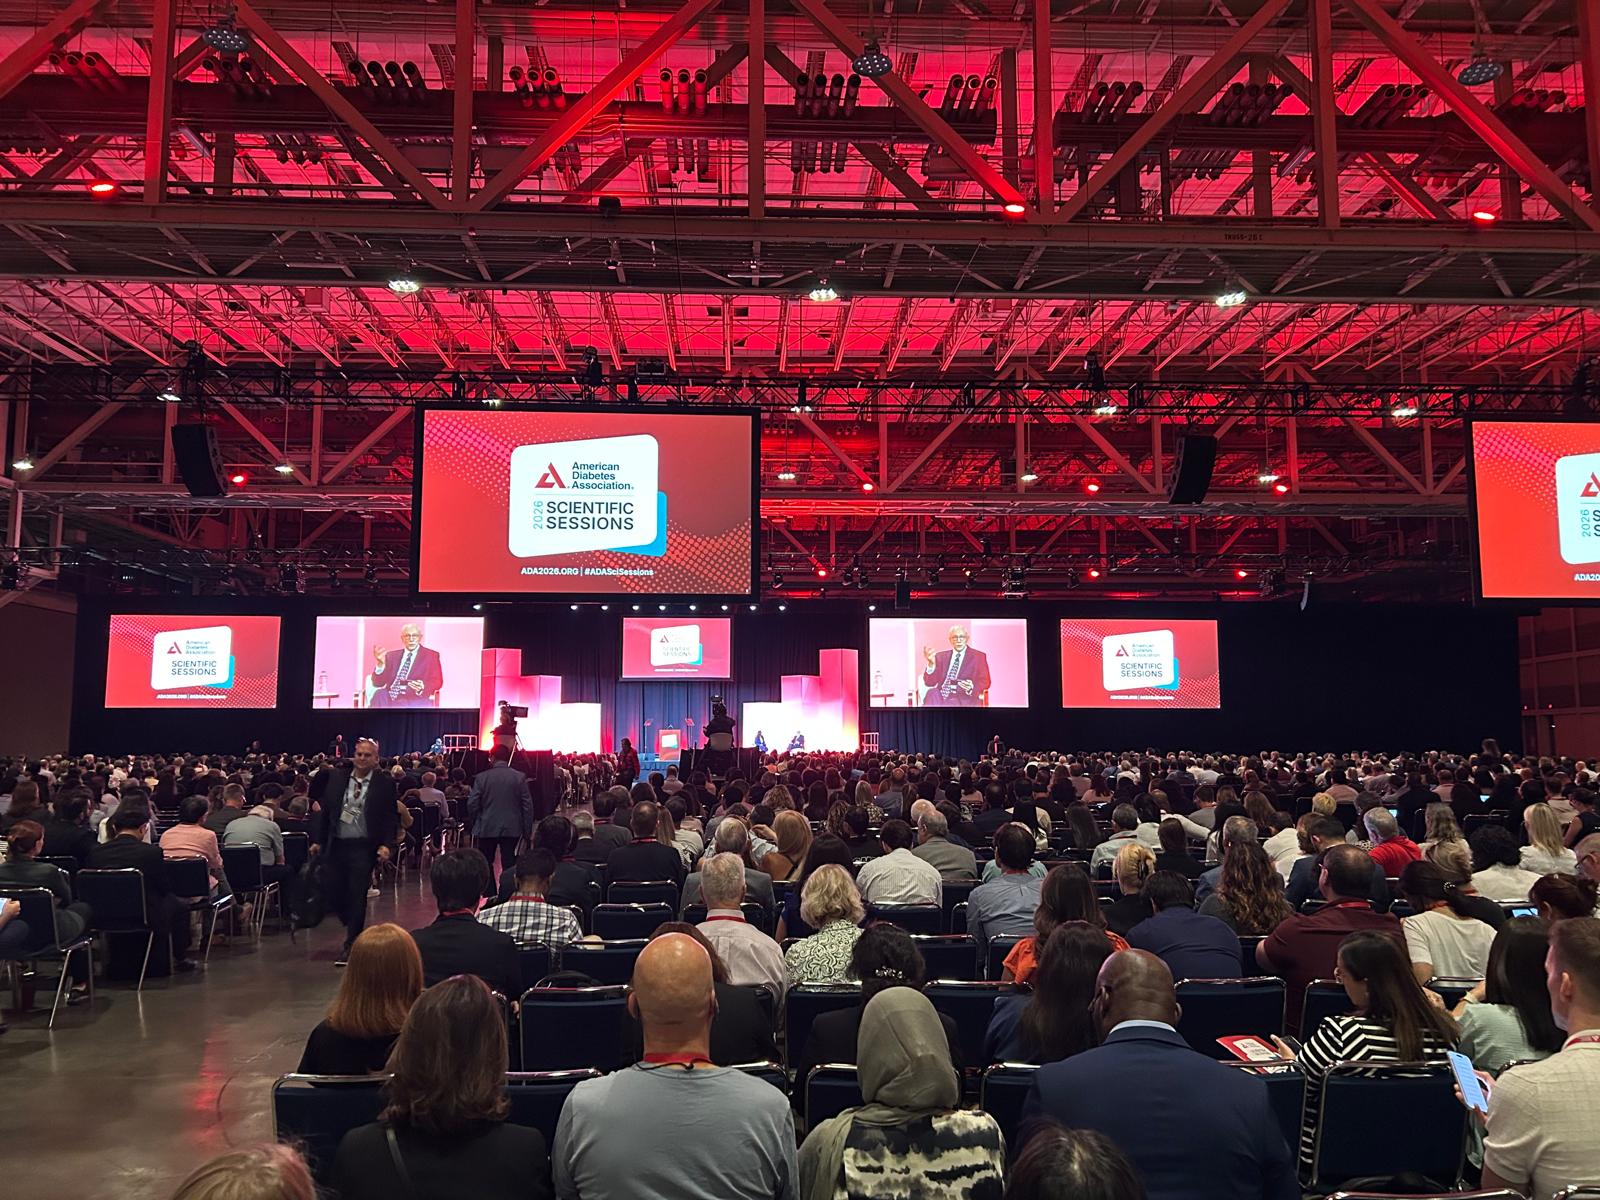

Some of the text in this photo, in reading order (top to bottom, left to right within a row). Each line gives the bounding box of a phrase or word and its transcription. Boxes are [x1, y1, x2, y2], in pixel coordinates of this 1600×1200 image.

[572, 461, 619, 470] American
[572, 471, 616, 480] Diabetes
[546, 501, 634, 515] SCIENTIFIC
[533, 500, 543, 530] 2026
[546, 516, 634, 530] SESSIONS
[1580, 509, 1591, 538] 2026
[521, 567, 579, 575] ADA2026.ORG
[585, 567, 654, 576] #ADASciSessions
[171, 668, 217, 676] SESSIONS
